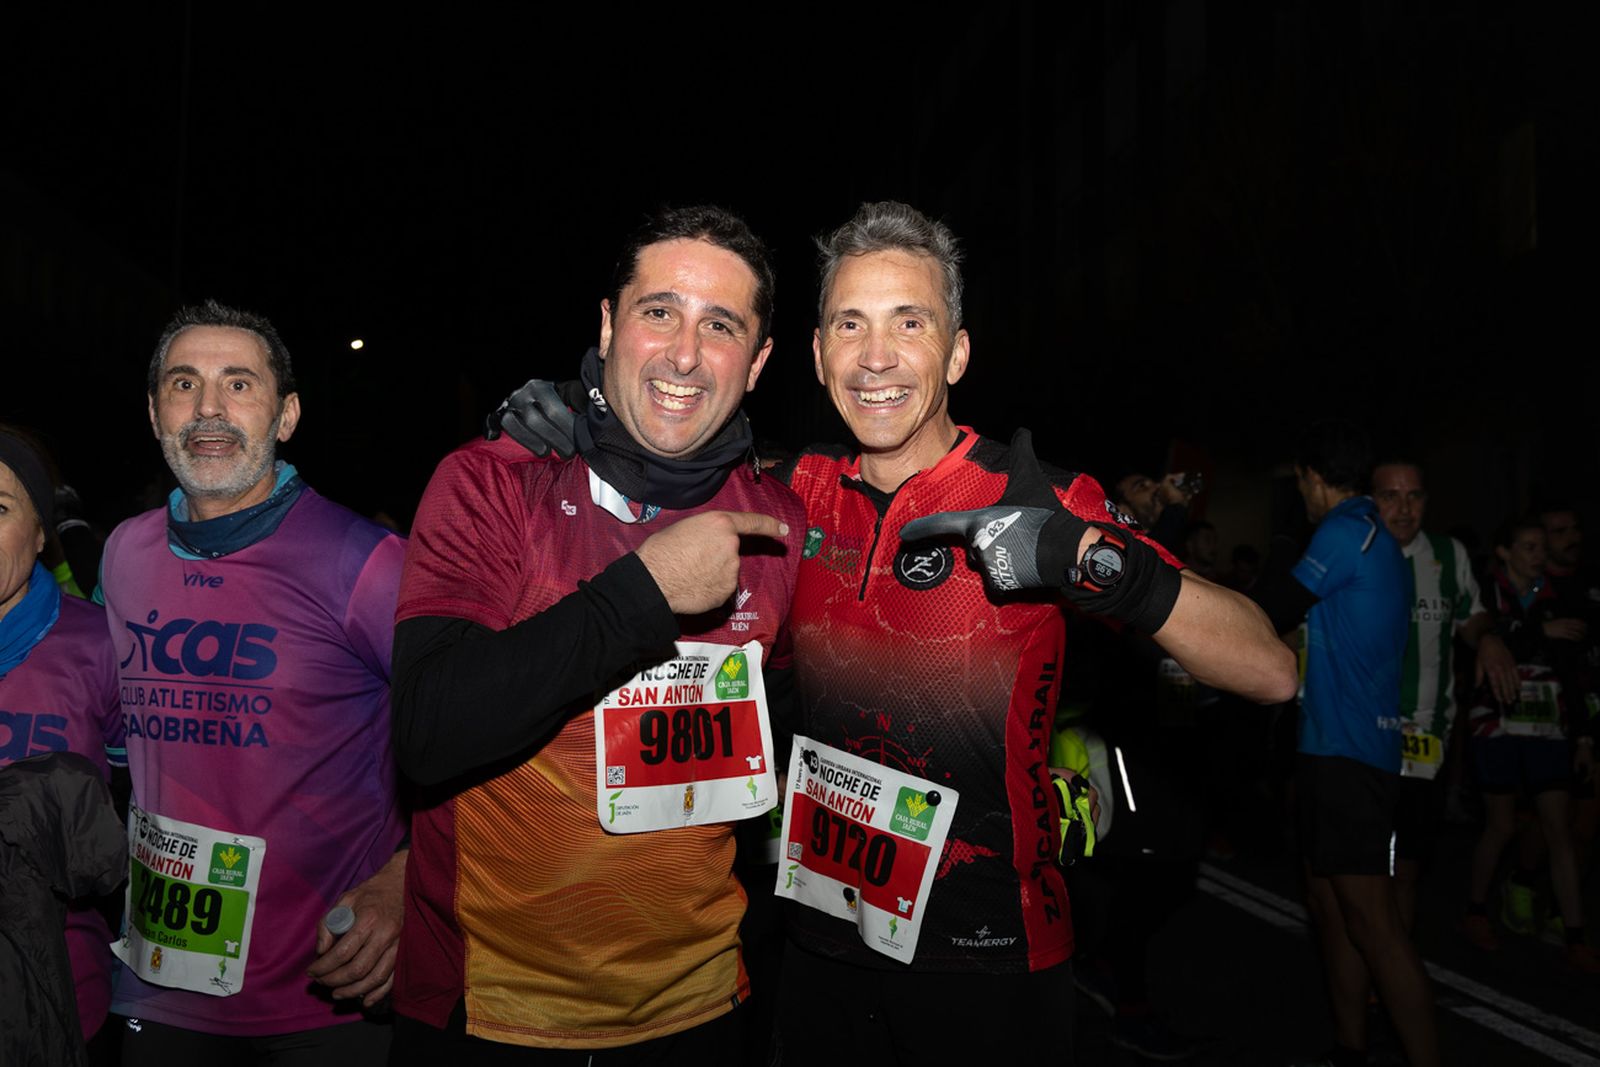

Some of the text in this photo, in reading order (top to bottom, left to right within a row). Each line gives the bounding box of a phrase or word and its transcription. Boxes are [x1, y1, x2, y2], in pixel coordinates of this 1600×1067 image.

[184, 571, 224, 588] vive
[151, 618, 278, 680] cas
[693, 662, 710, 680] DE
[121, 686, 272, 716] CLUB ATLETISMO
[618, 680, 704, 707] SAN ANTÓN
[640, 706, 735, 766] 9801
[819, 764, 882, 802] NOCHE DE
[805, 778, 876, 824] SAN ANTÓN
[148, 828, 180, 854] NOCHE
[178, 842, 198, 860] DE
[136, 843, 194, 881] SAN ANTÓN
[158, 930, 188, 948] Carlos
